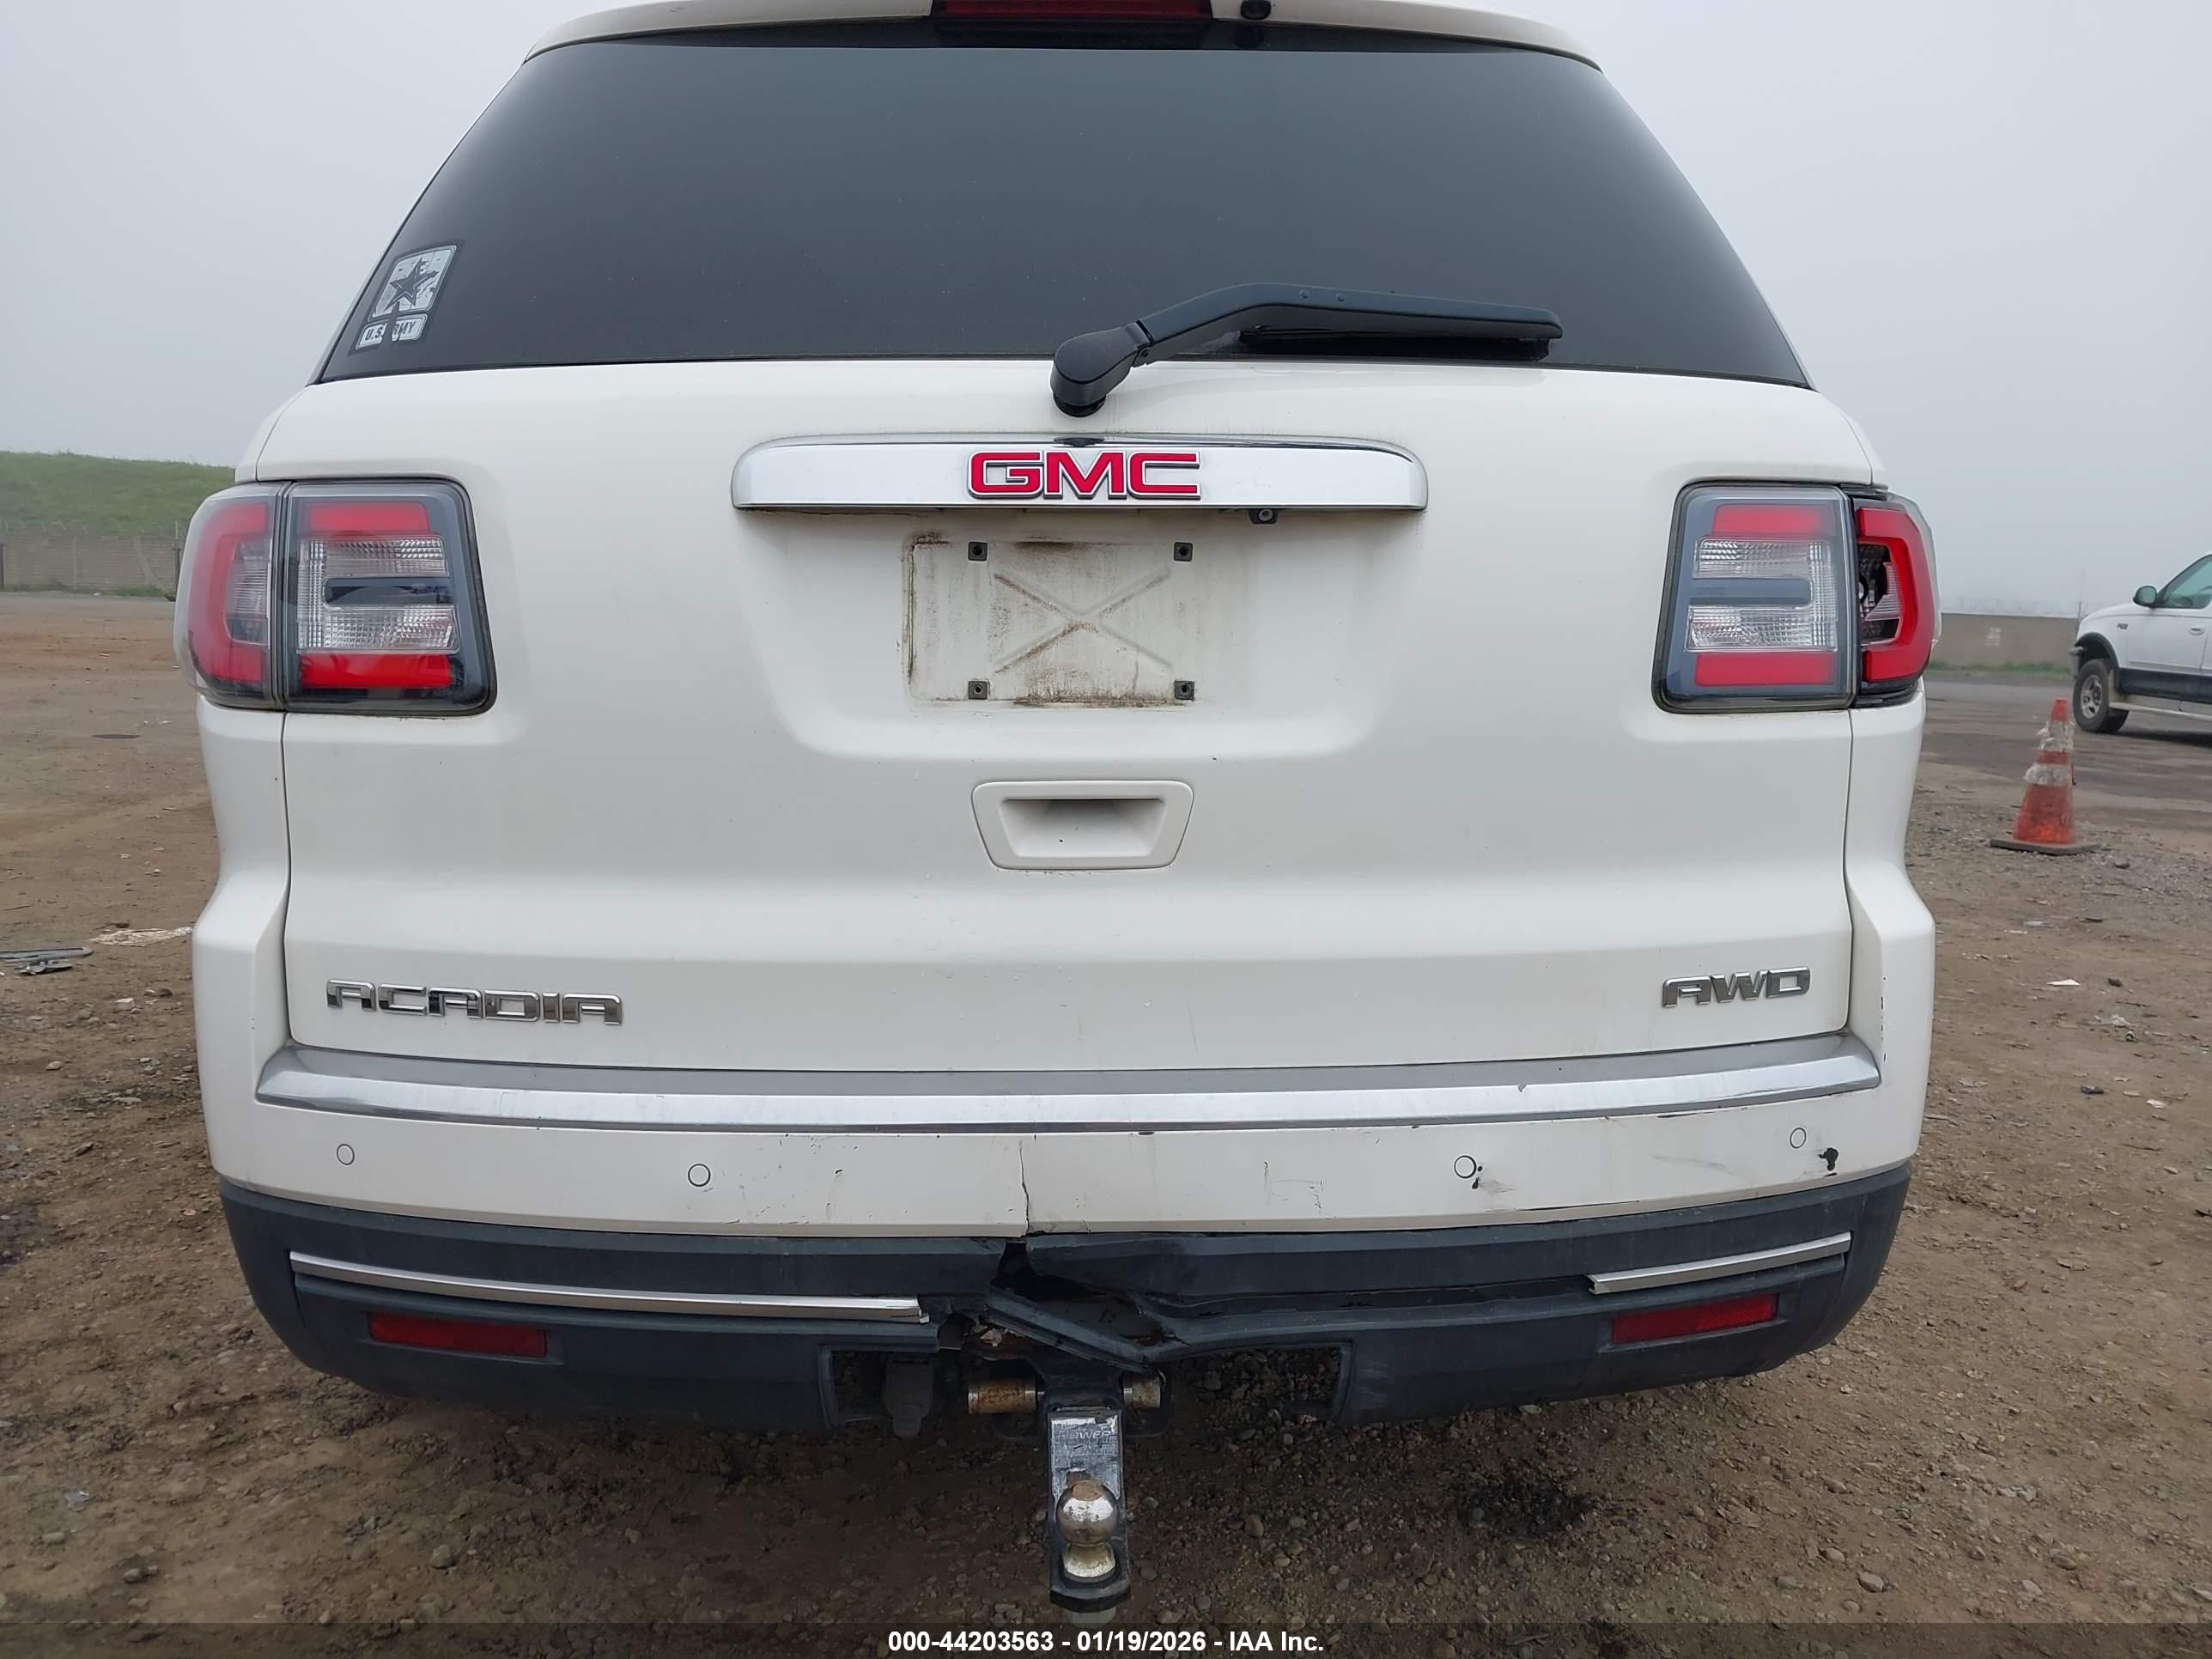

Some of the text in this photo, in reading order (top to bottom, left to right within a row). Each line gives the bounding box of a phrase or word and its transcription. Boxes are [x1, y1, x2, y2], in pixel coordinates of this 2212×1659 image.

[969, 451, 1201, 500] GMC
[325, 978, 623, 1025] ACADIA
[1662, 966, 1811, 1008] AWD
